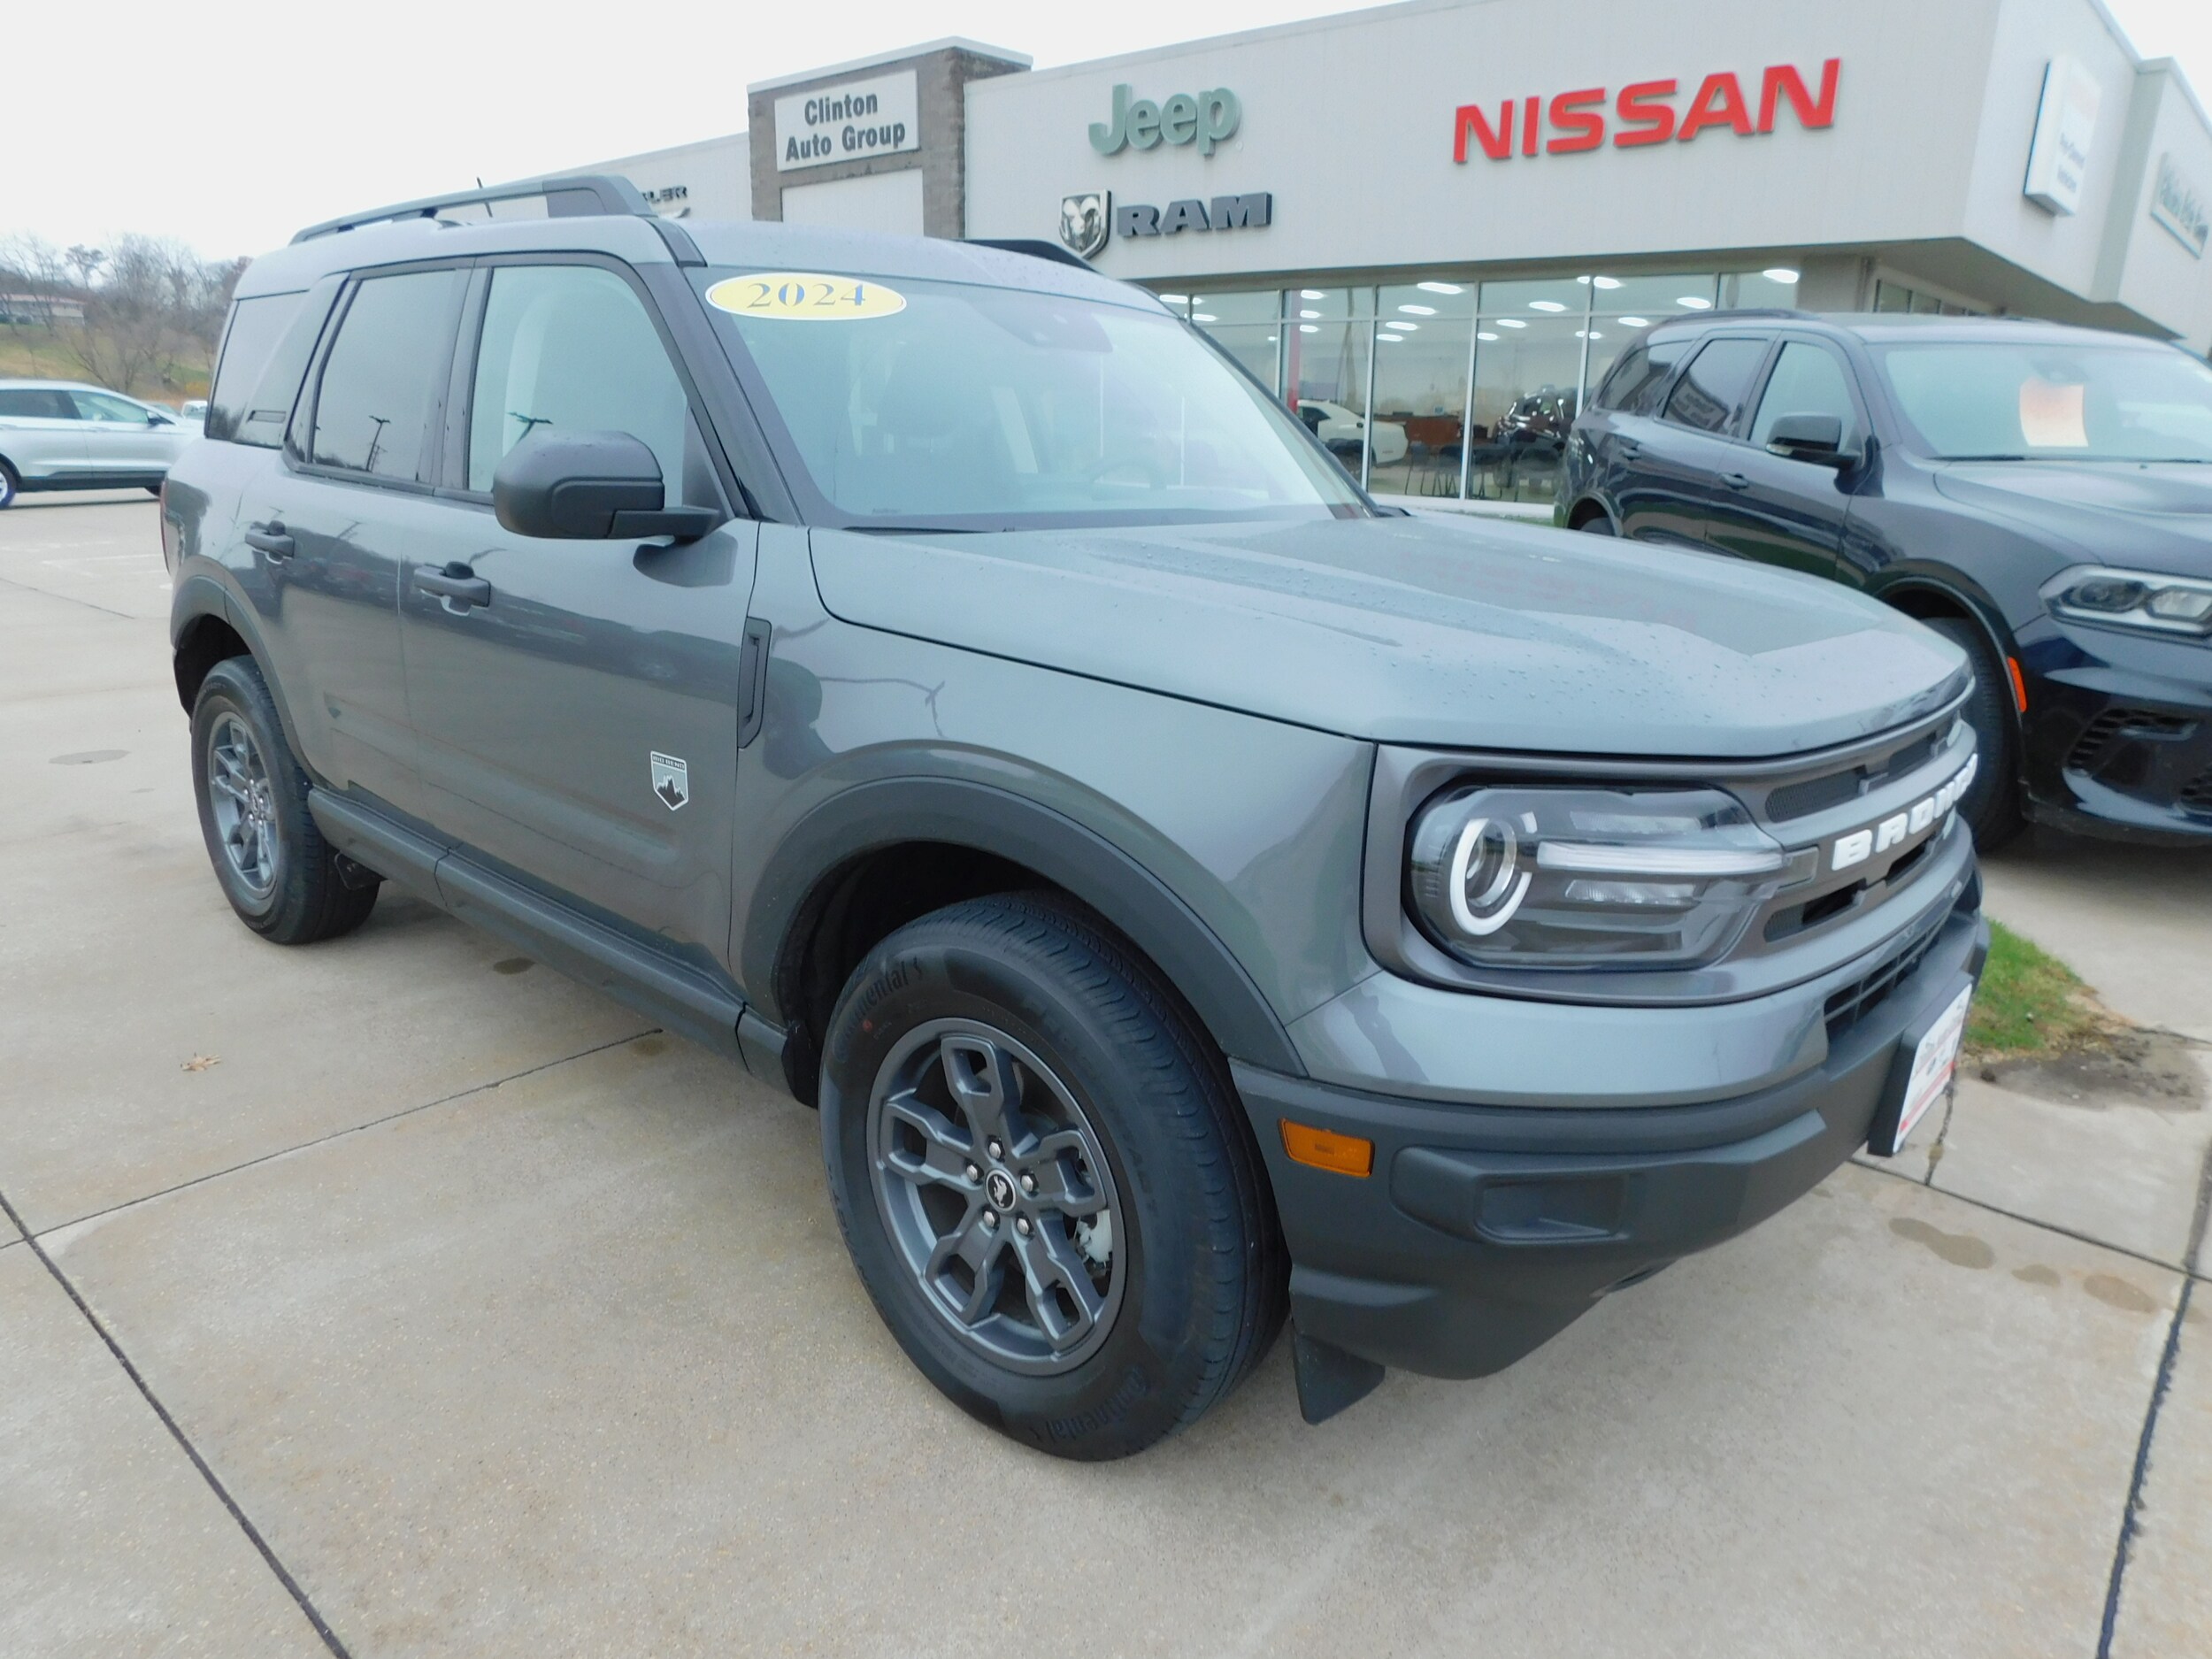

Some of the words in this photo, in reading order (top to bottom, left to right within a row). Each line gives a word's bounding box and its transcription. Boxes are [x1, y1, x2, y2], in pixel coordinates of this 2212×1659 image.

[804, 92, 879, 127] Clinton
[1087, 83, 1242, 158] Jeep
[1453, 57, 1842, 165] NISSAN
[786, 135, 833, 163] Auto
[841, 120, 906, 153] Group
[1117, 191, 1273, 240] RAM
[746, 282, 866, 310] 2024
